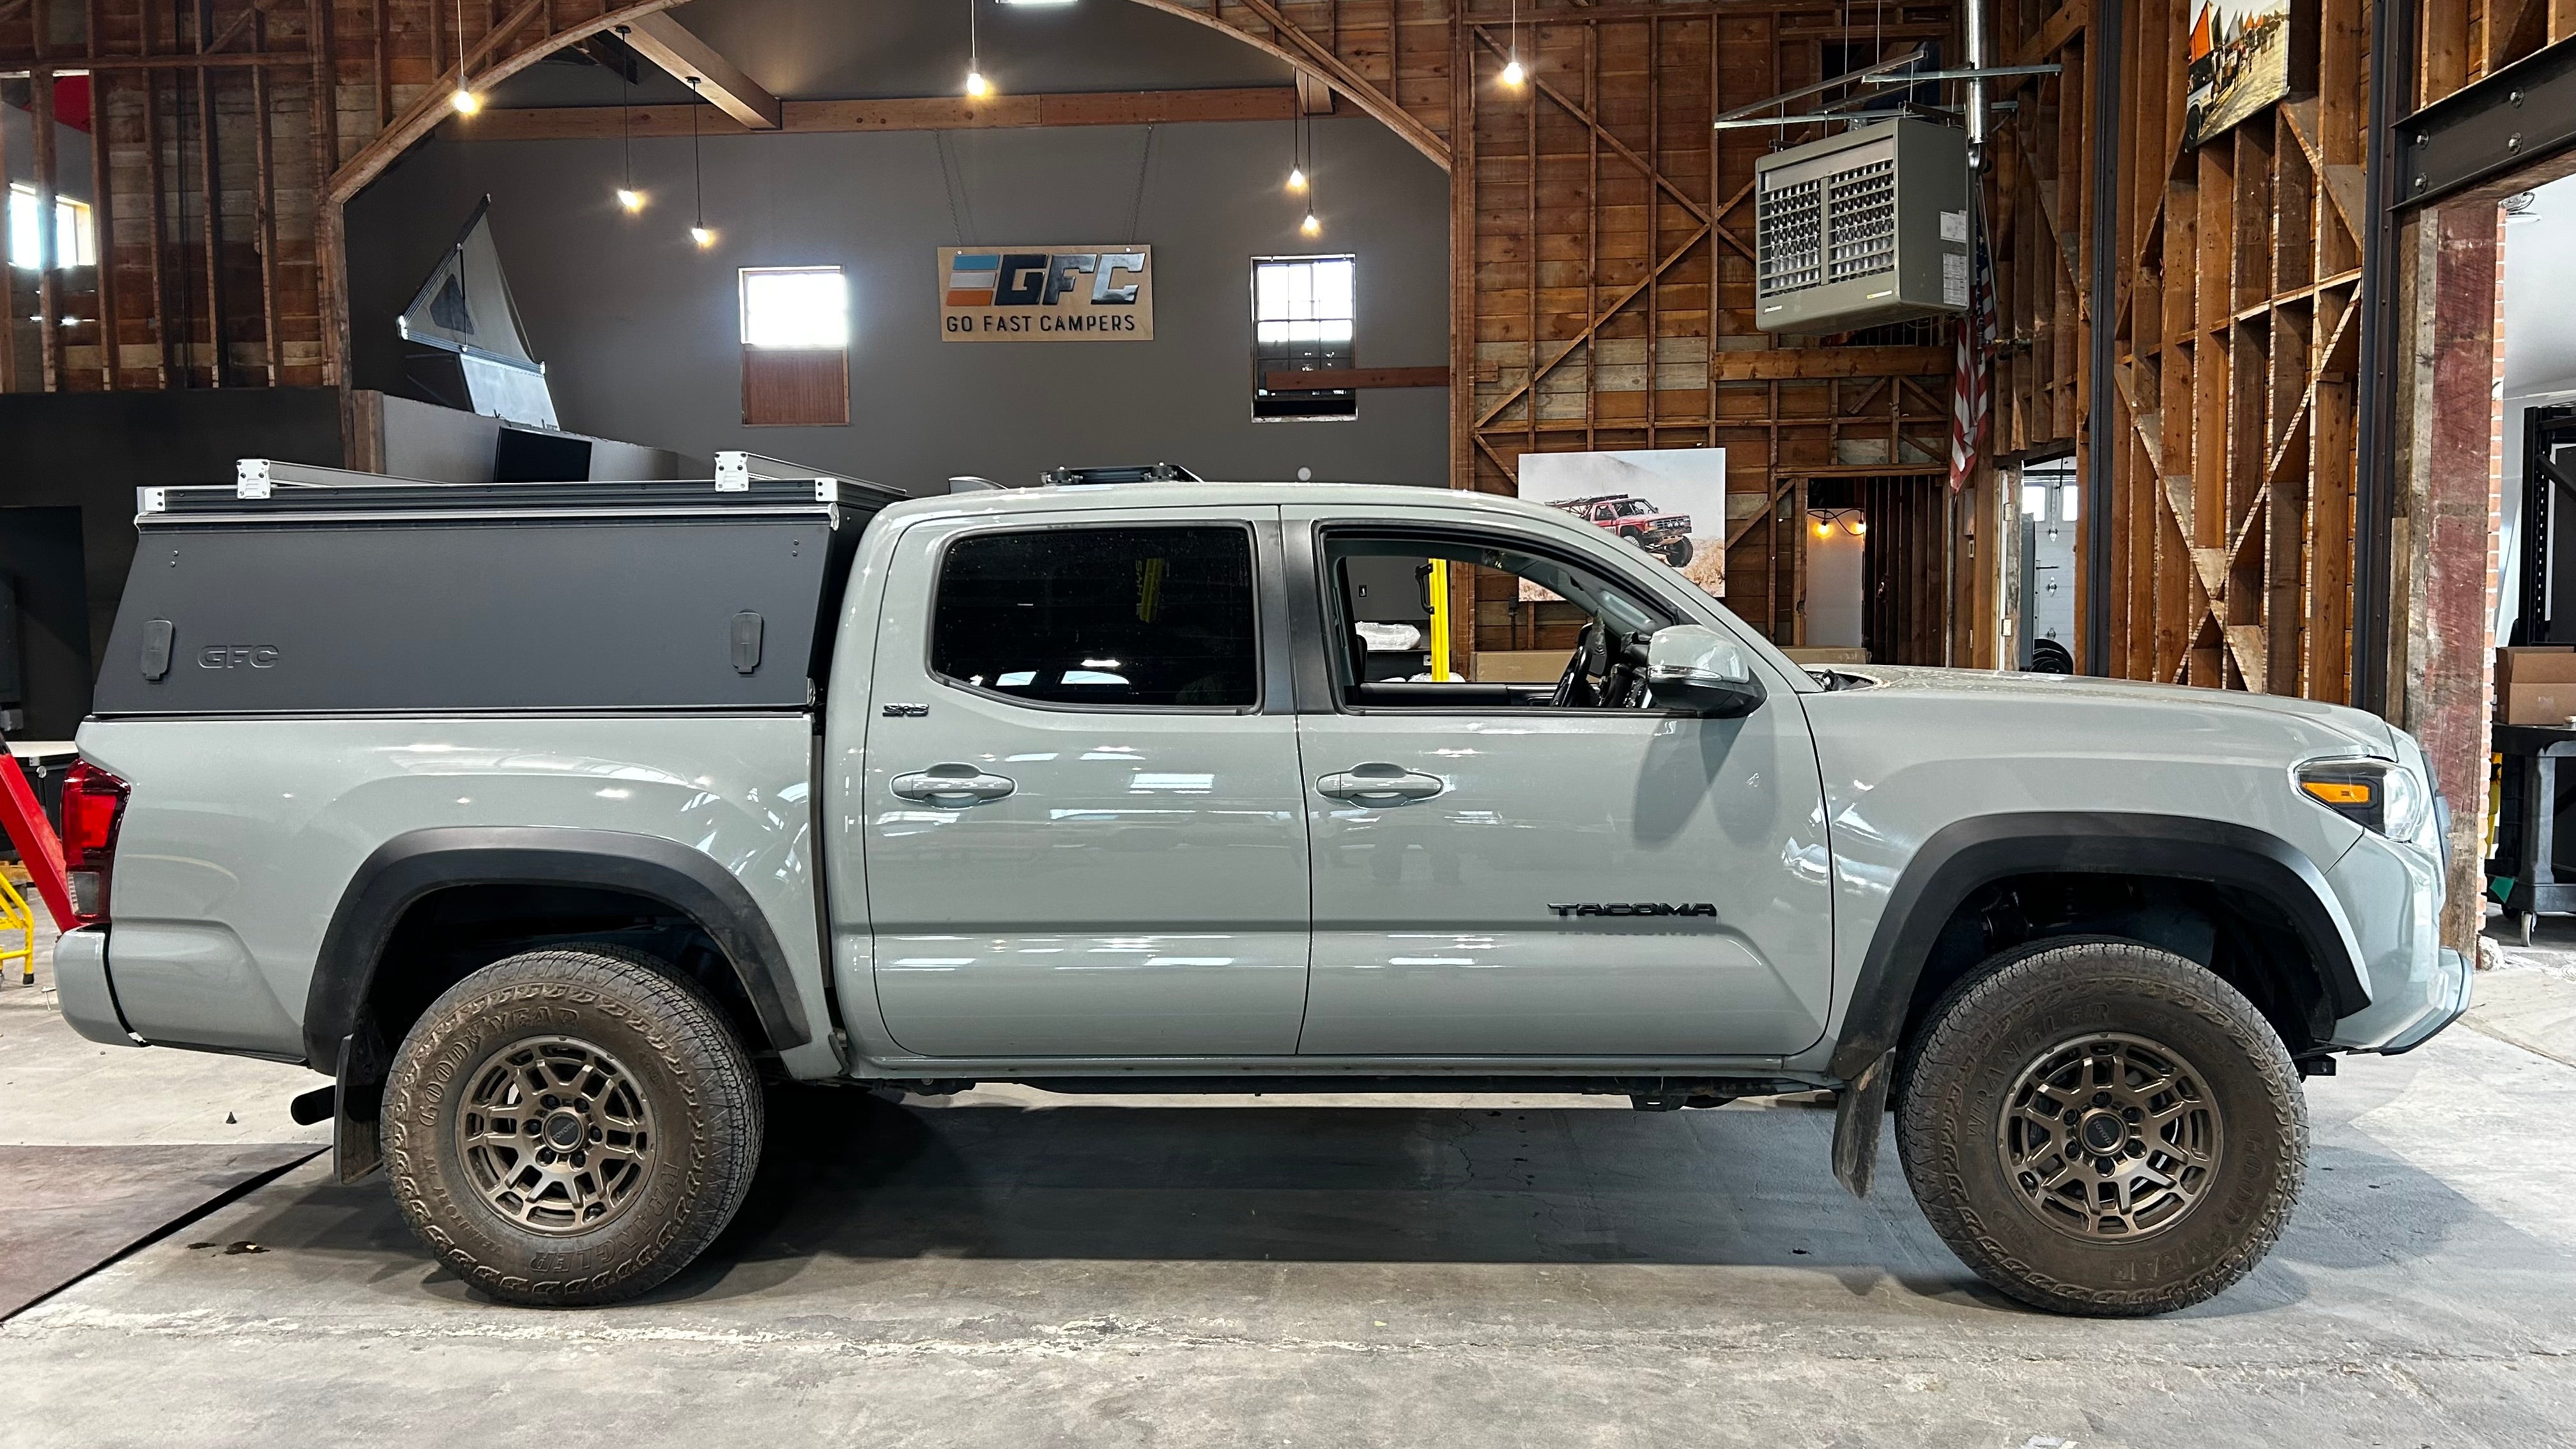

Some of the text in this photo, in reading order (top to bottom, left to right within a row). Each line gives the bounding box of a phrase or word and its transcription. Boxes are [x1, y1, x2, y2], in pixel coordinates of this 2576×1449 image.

[994, 253, 1146, 305] GFC
[946, 315, 1135, 332] GO FAST CAMPERS
[198, 645, 279, 668] GFC
[1547, 903, 1717, 916] TACOMA
[552, 1122, 576, 1140] TOYOTA
[2093, 1120, 2112, 1146] TOYOTA
